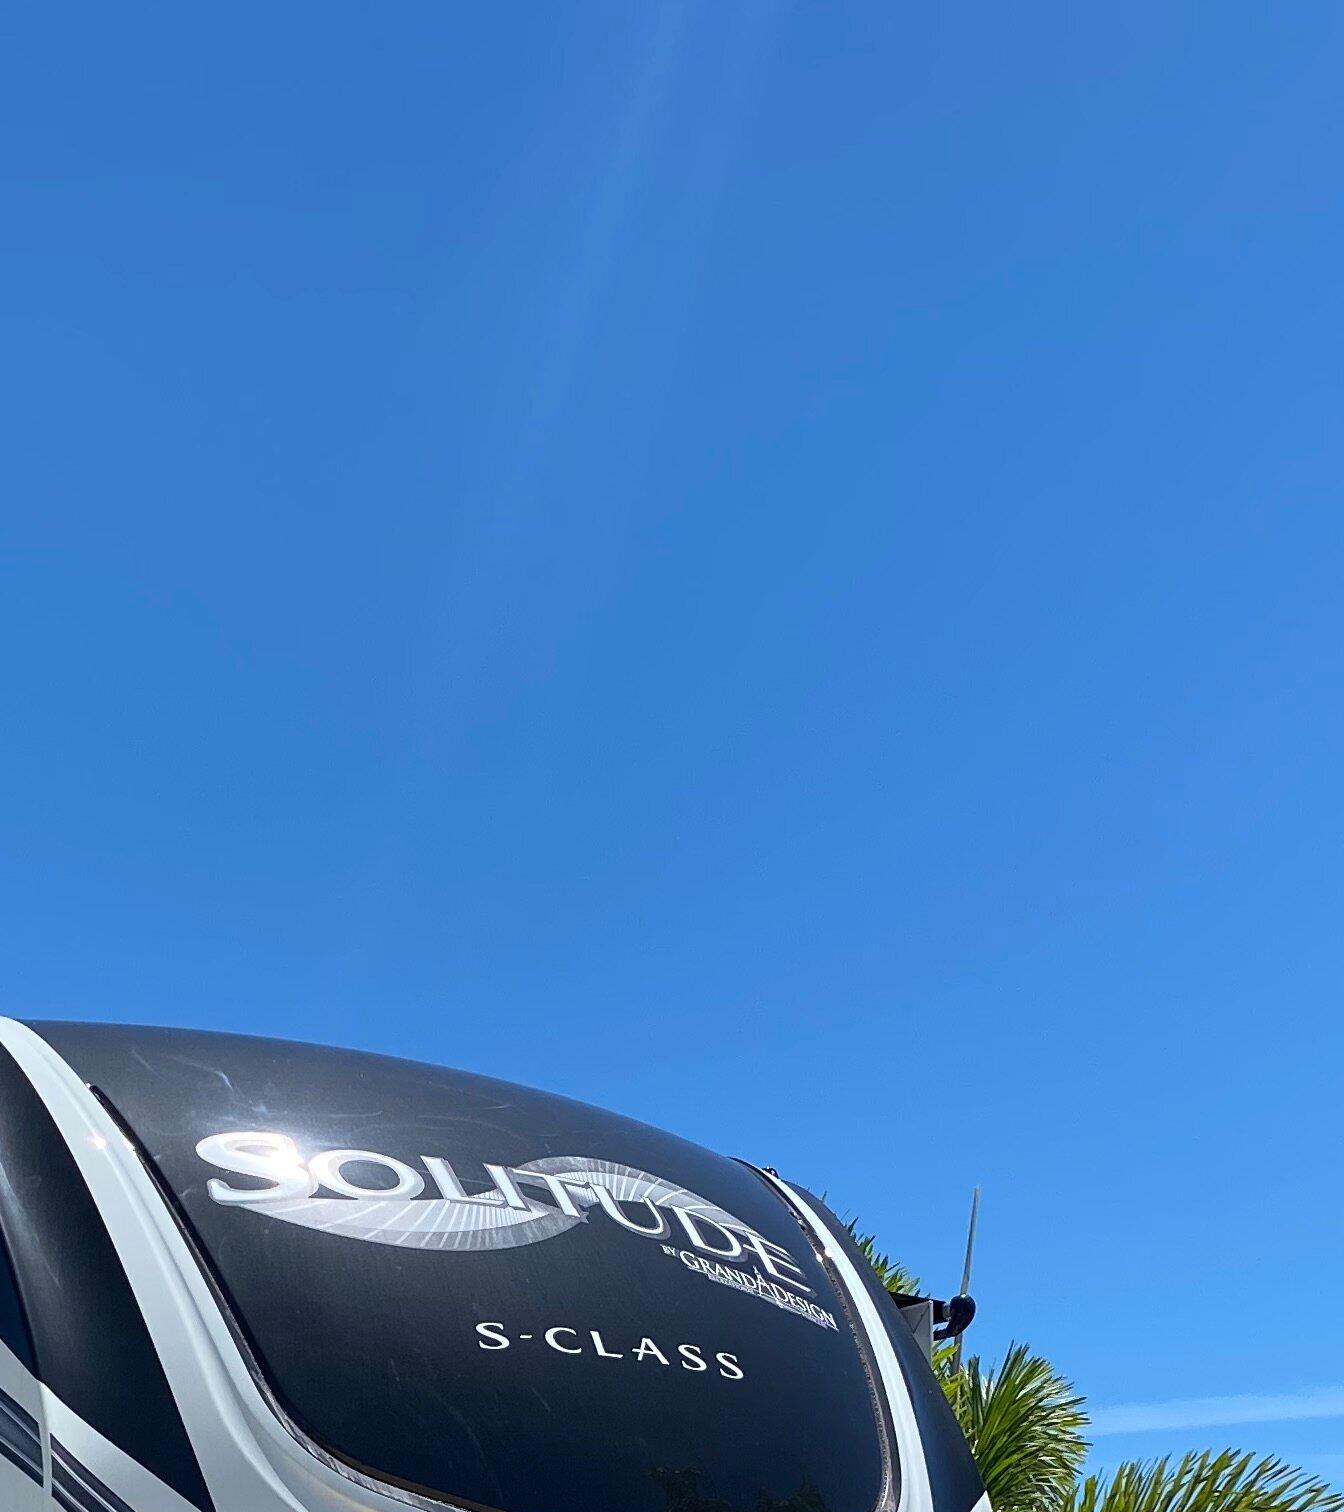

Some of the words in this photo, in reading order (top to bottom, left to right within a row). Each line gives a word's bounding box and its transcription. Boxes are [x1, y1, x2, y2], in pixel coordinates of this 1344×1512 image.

[196, 1131, 814, 1294] SOLITUDE
[659, 1243, 676, 1257] BY
[679, 1250, 757, 1290] GRAND
[771, 1285, 840, 1333] DESIGN
[476, 1322, 745, 1379] S-CLASS
